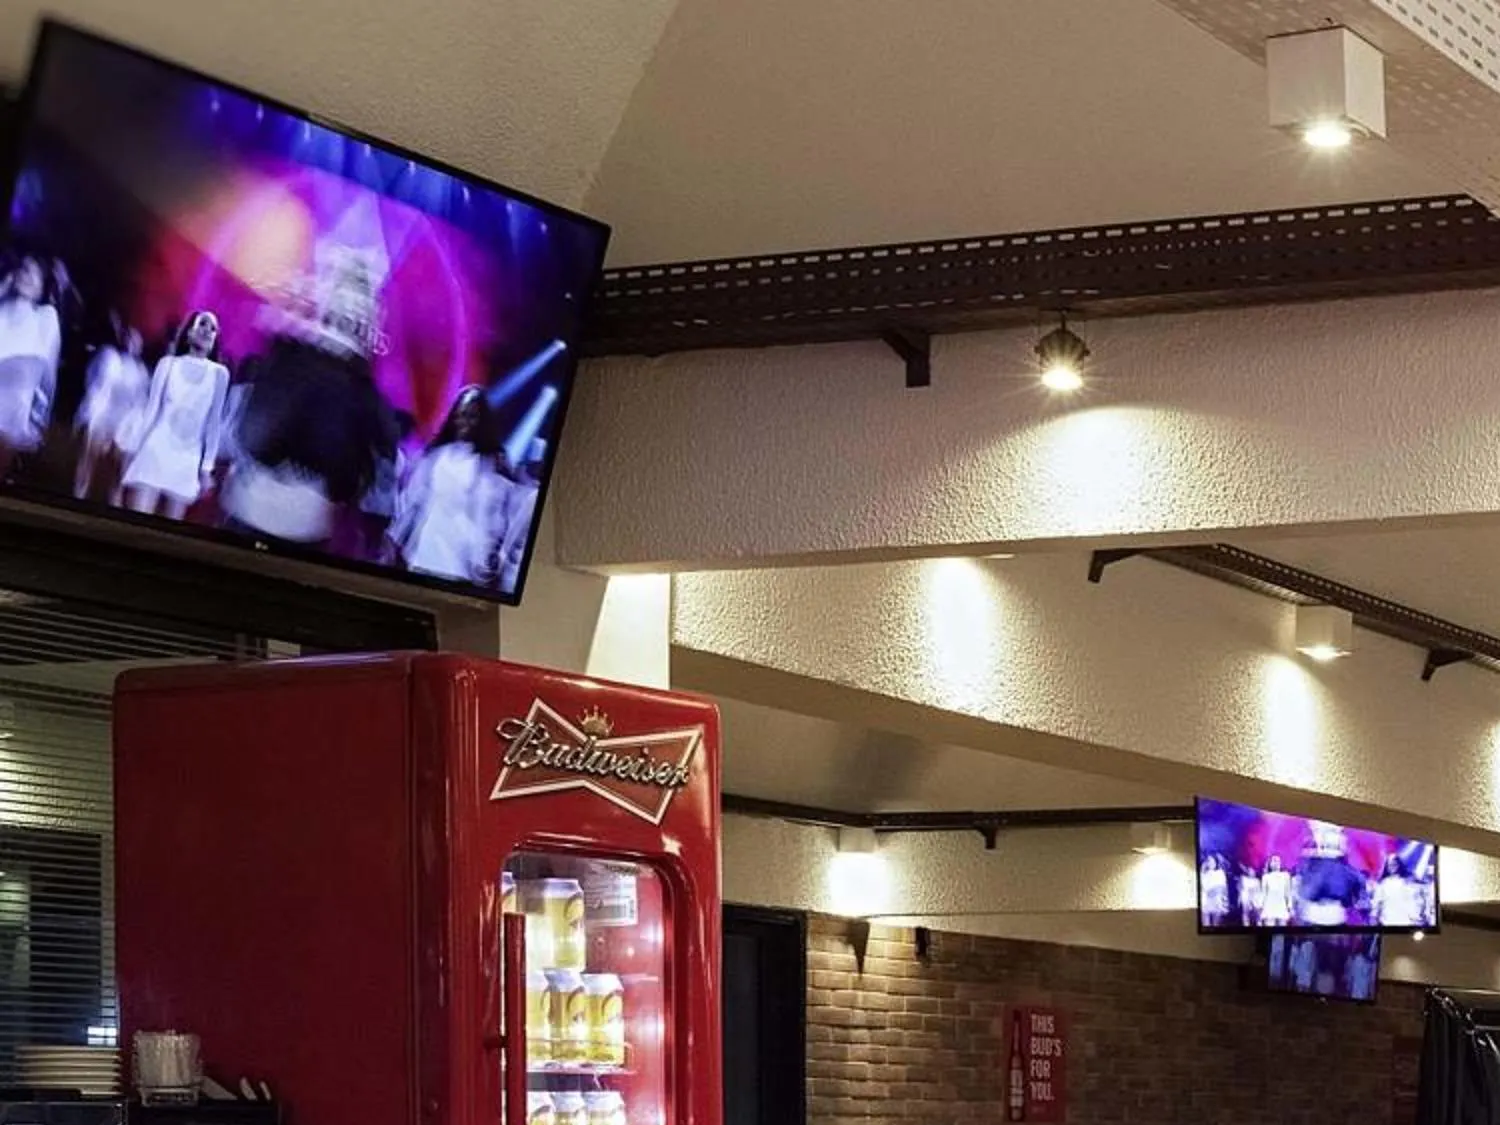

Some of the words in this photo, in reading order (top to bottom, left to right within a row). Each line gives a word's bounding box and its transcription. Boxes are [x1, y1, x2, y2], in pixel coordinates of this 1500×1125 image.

[496, 717, 690, 787] Budweiser
[1031, 1013, 1055, 1033] THIS
[1031, 1036, 1061, 1056] BUD'S
[1030, 1059, 1051, 1078] FOR
